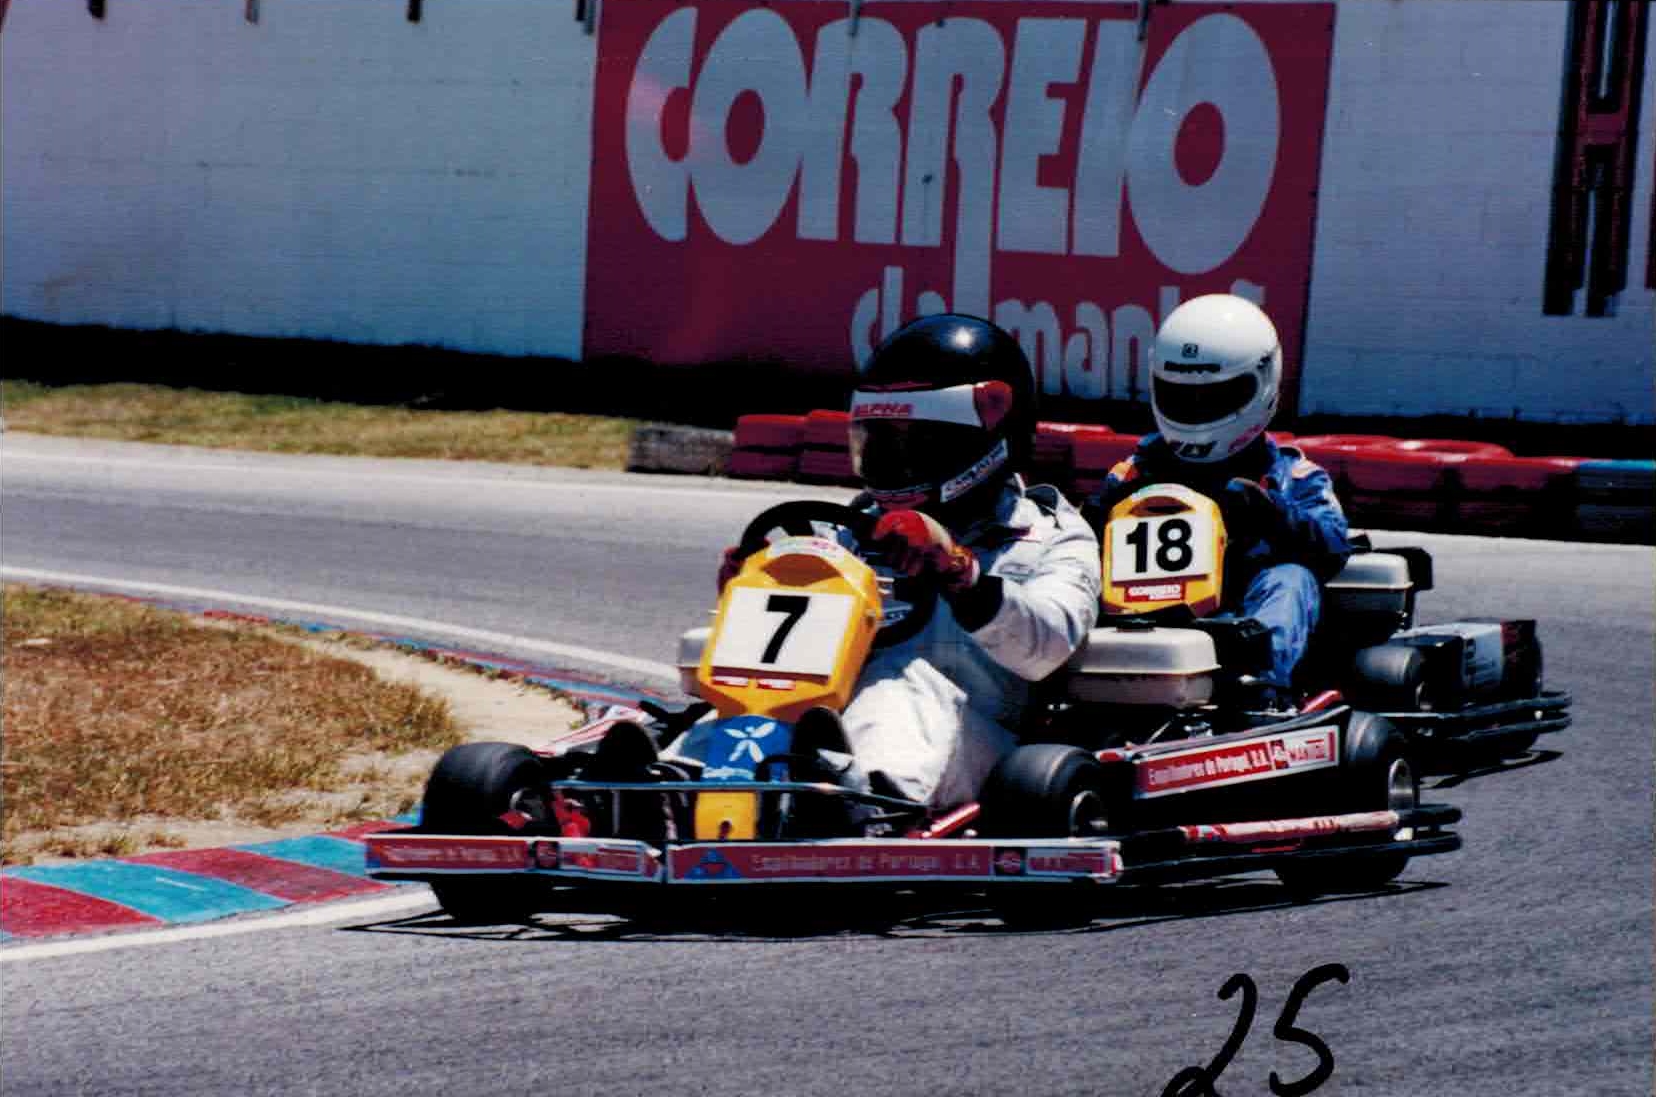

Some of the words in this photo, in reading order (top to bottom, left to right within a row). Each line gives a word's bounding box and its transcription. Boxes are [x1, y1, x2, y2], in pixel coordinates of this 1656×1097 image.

[626, 6, 1281, 276] CORREIO
[1125, 518, 1193, 573] 18
[760, 594, 810, 665] 7
